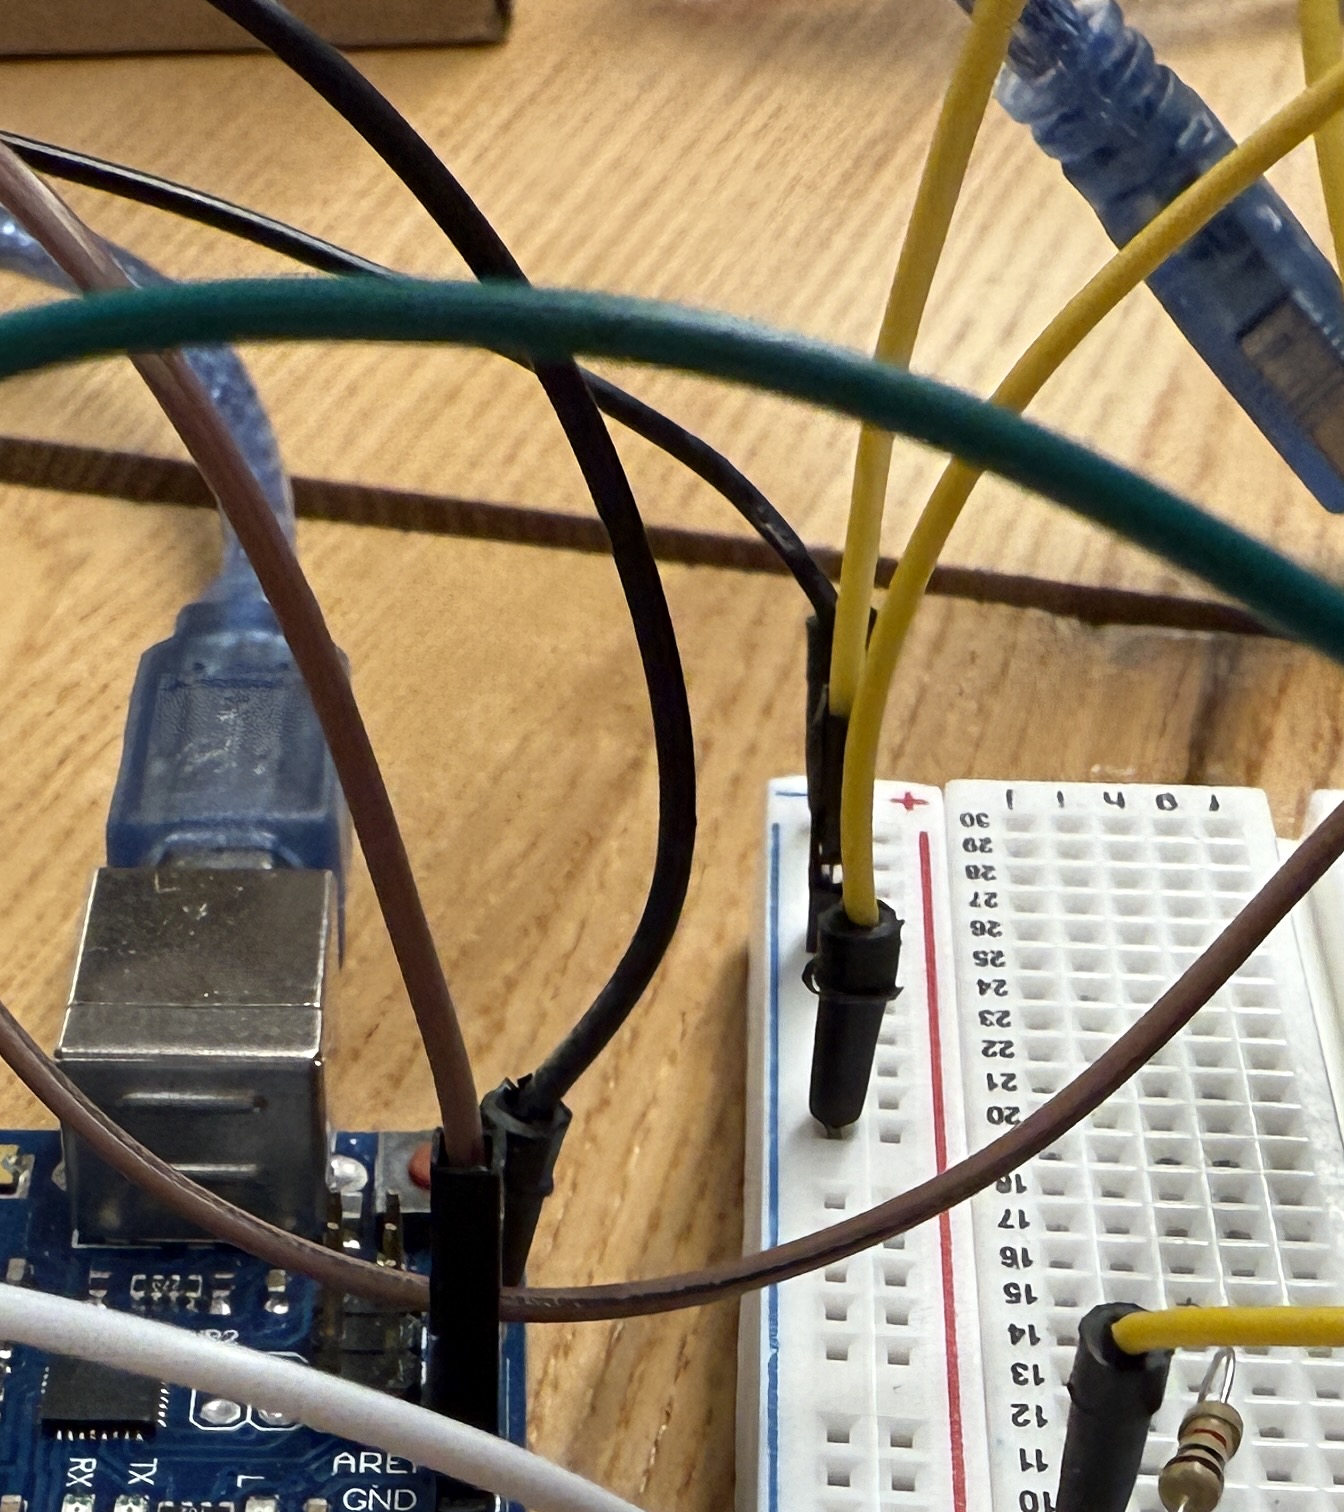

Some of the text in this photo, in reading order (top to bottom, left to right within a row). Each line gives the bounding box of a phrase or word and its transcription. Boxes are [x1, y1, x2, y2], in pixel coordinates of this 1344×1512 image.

[969, 891, 998, 908] 27
[970, 920, 1003, 938] 26
[972, 950, 1006, 967] 25
[977, 979, 1008, 996] 24
[978, 1010, 1011, 1028] 23
[981, 1040, 1015, 1058] 22
[987, 1073, 1017, 1091] 21
[986, 1105, 1021, 1125] 20
[997, 1208, 1030, 1229] 17
[999, 1246, 1034, 1270] 16
[1003, 1282, 1038, 1305] 15
[1008, 1323, 1041, 1346] 14
[1010, 1362, 1045, 1386] 13
[1010, 1403, 1049, 1428] 12
[1019, 1448, 1049, 1472] 11
[66, 1458, 97, 1487] RX
[128, 1458, 158, 1486] TX
[237, 1475, 265, 1488] L
[342, 1488, 417, 1511] GND
